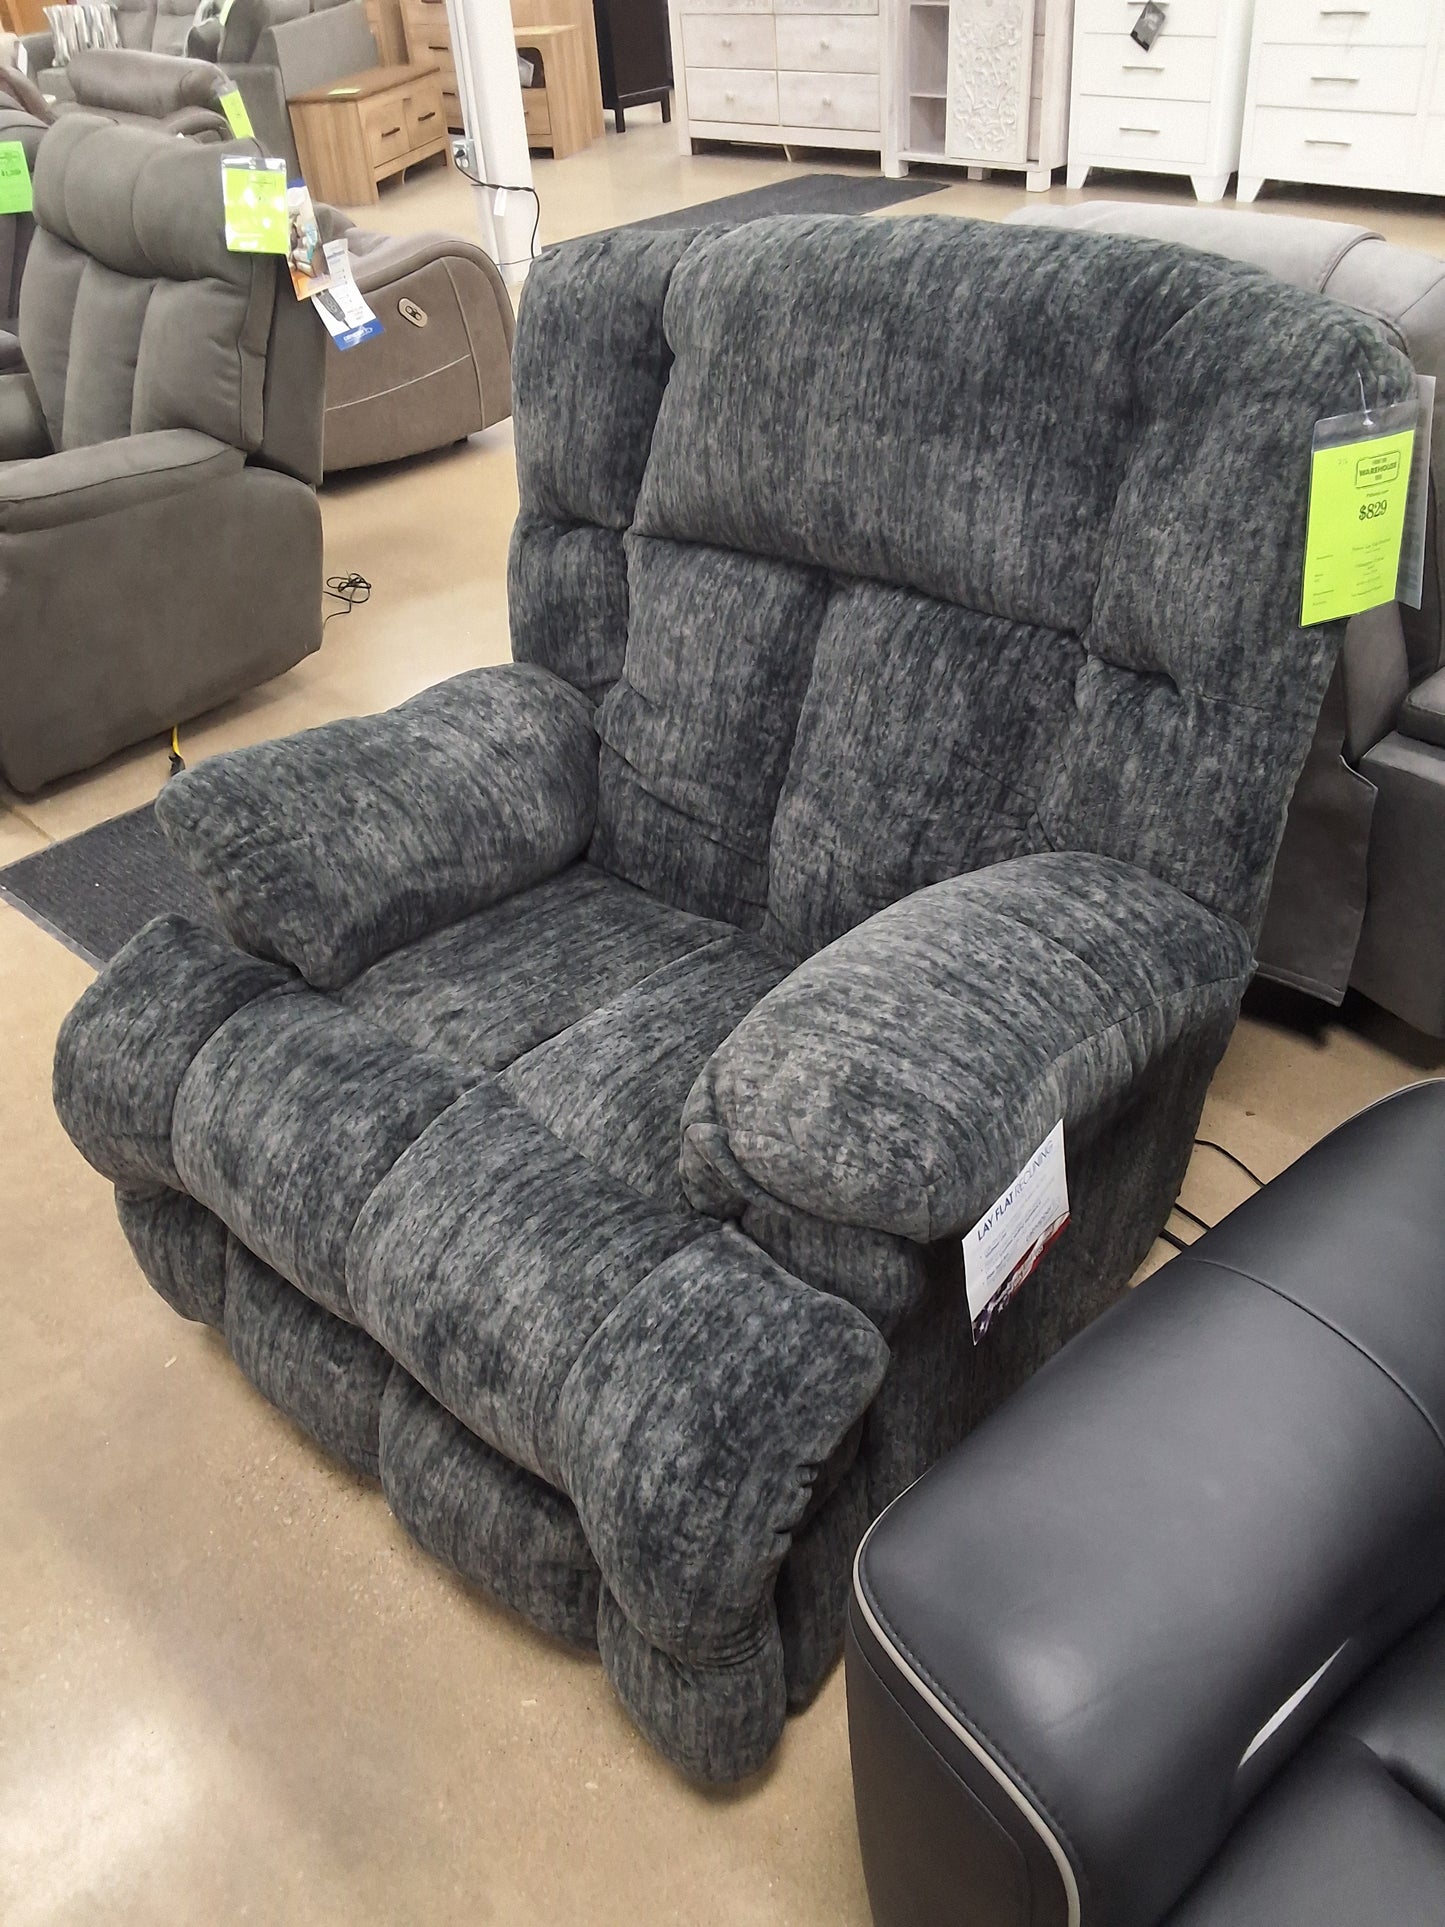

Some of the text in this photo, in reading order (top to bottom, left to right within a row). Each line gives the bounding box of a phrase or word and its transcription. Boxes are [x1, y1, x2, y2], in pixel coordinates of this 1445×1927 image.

[1358, 499, 1388, 521] $829
[977, 1213, 994, 1241] LAY
[995, 1191, 1014, 1221] FLAT
[1014, 1139, 1054, 1197] RECLINING
